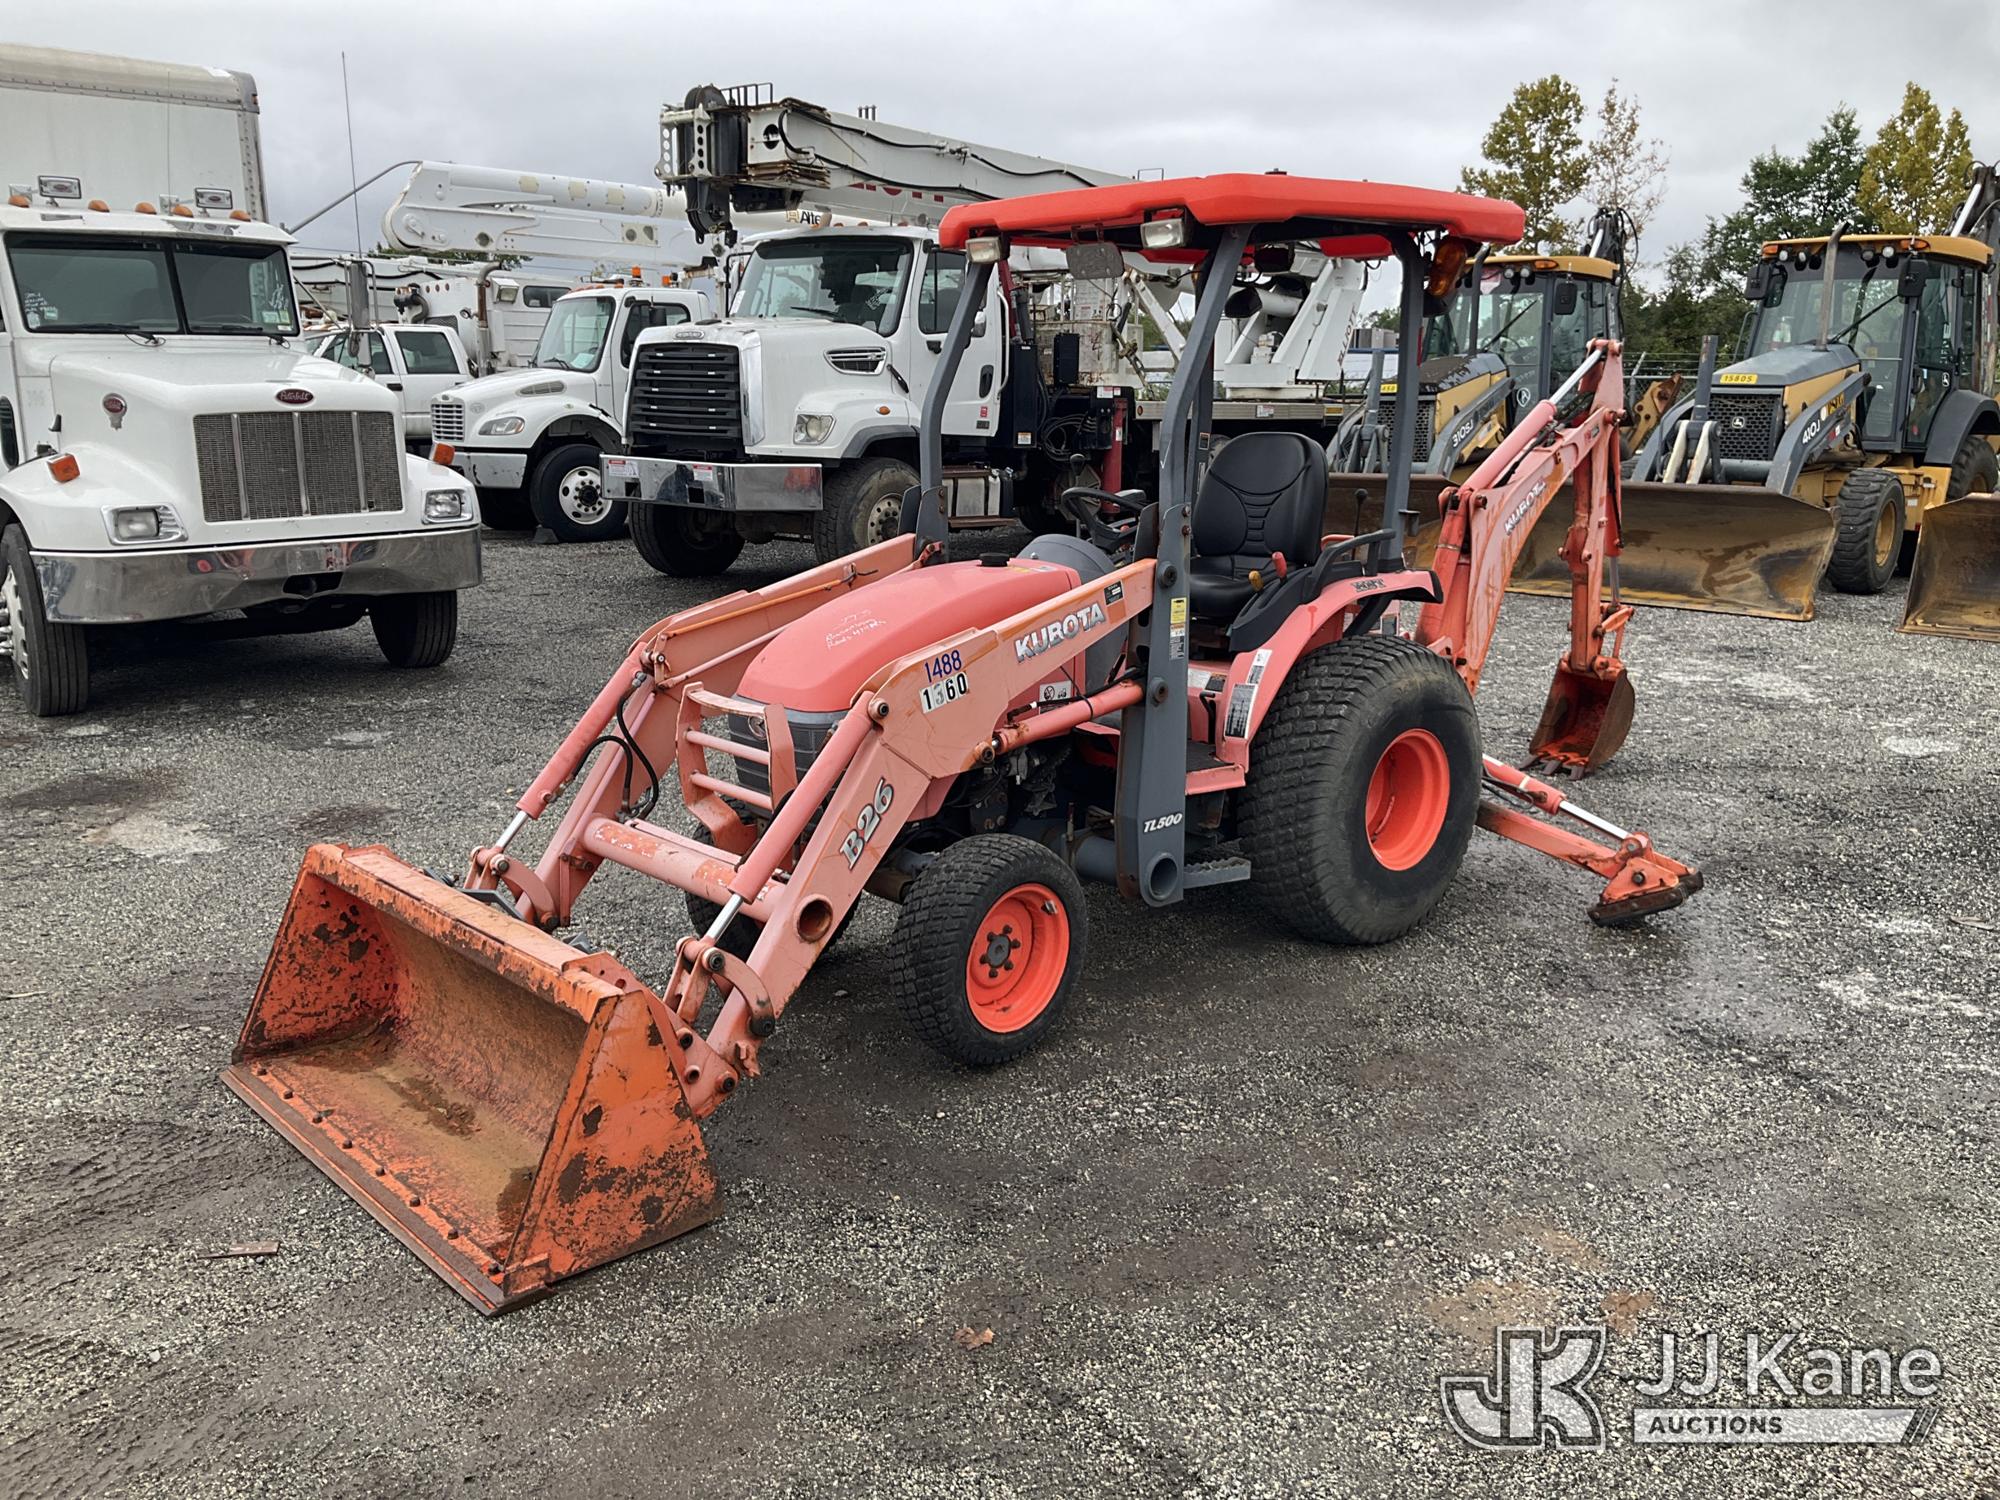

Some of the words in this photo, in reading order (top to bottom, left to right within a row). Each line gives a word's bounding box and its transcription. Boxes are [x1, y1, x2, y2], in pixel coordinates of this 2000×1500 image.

[800, 210, 822, 225] Alte
[1802, 419, 1821, 445] 410J
[1014, 602, 1107, 663] KUBOTA
[924, 649, 962, 683] 1488
[922, 672, 968, 711] 1360
[838, 776, 895, 872] B26
[1143, 812, 1183, 833] TL500
